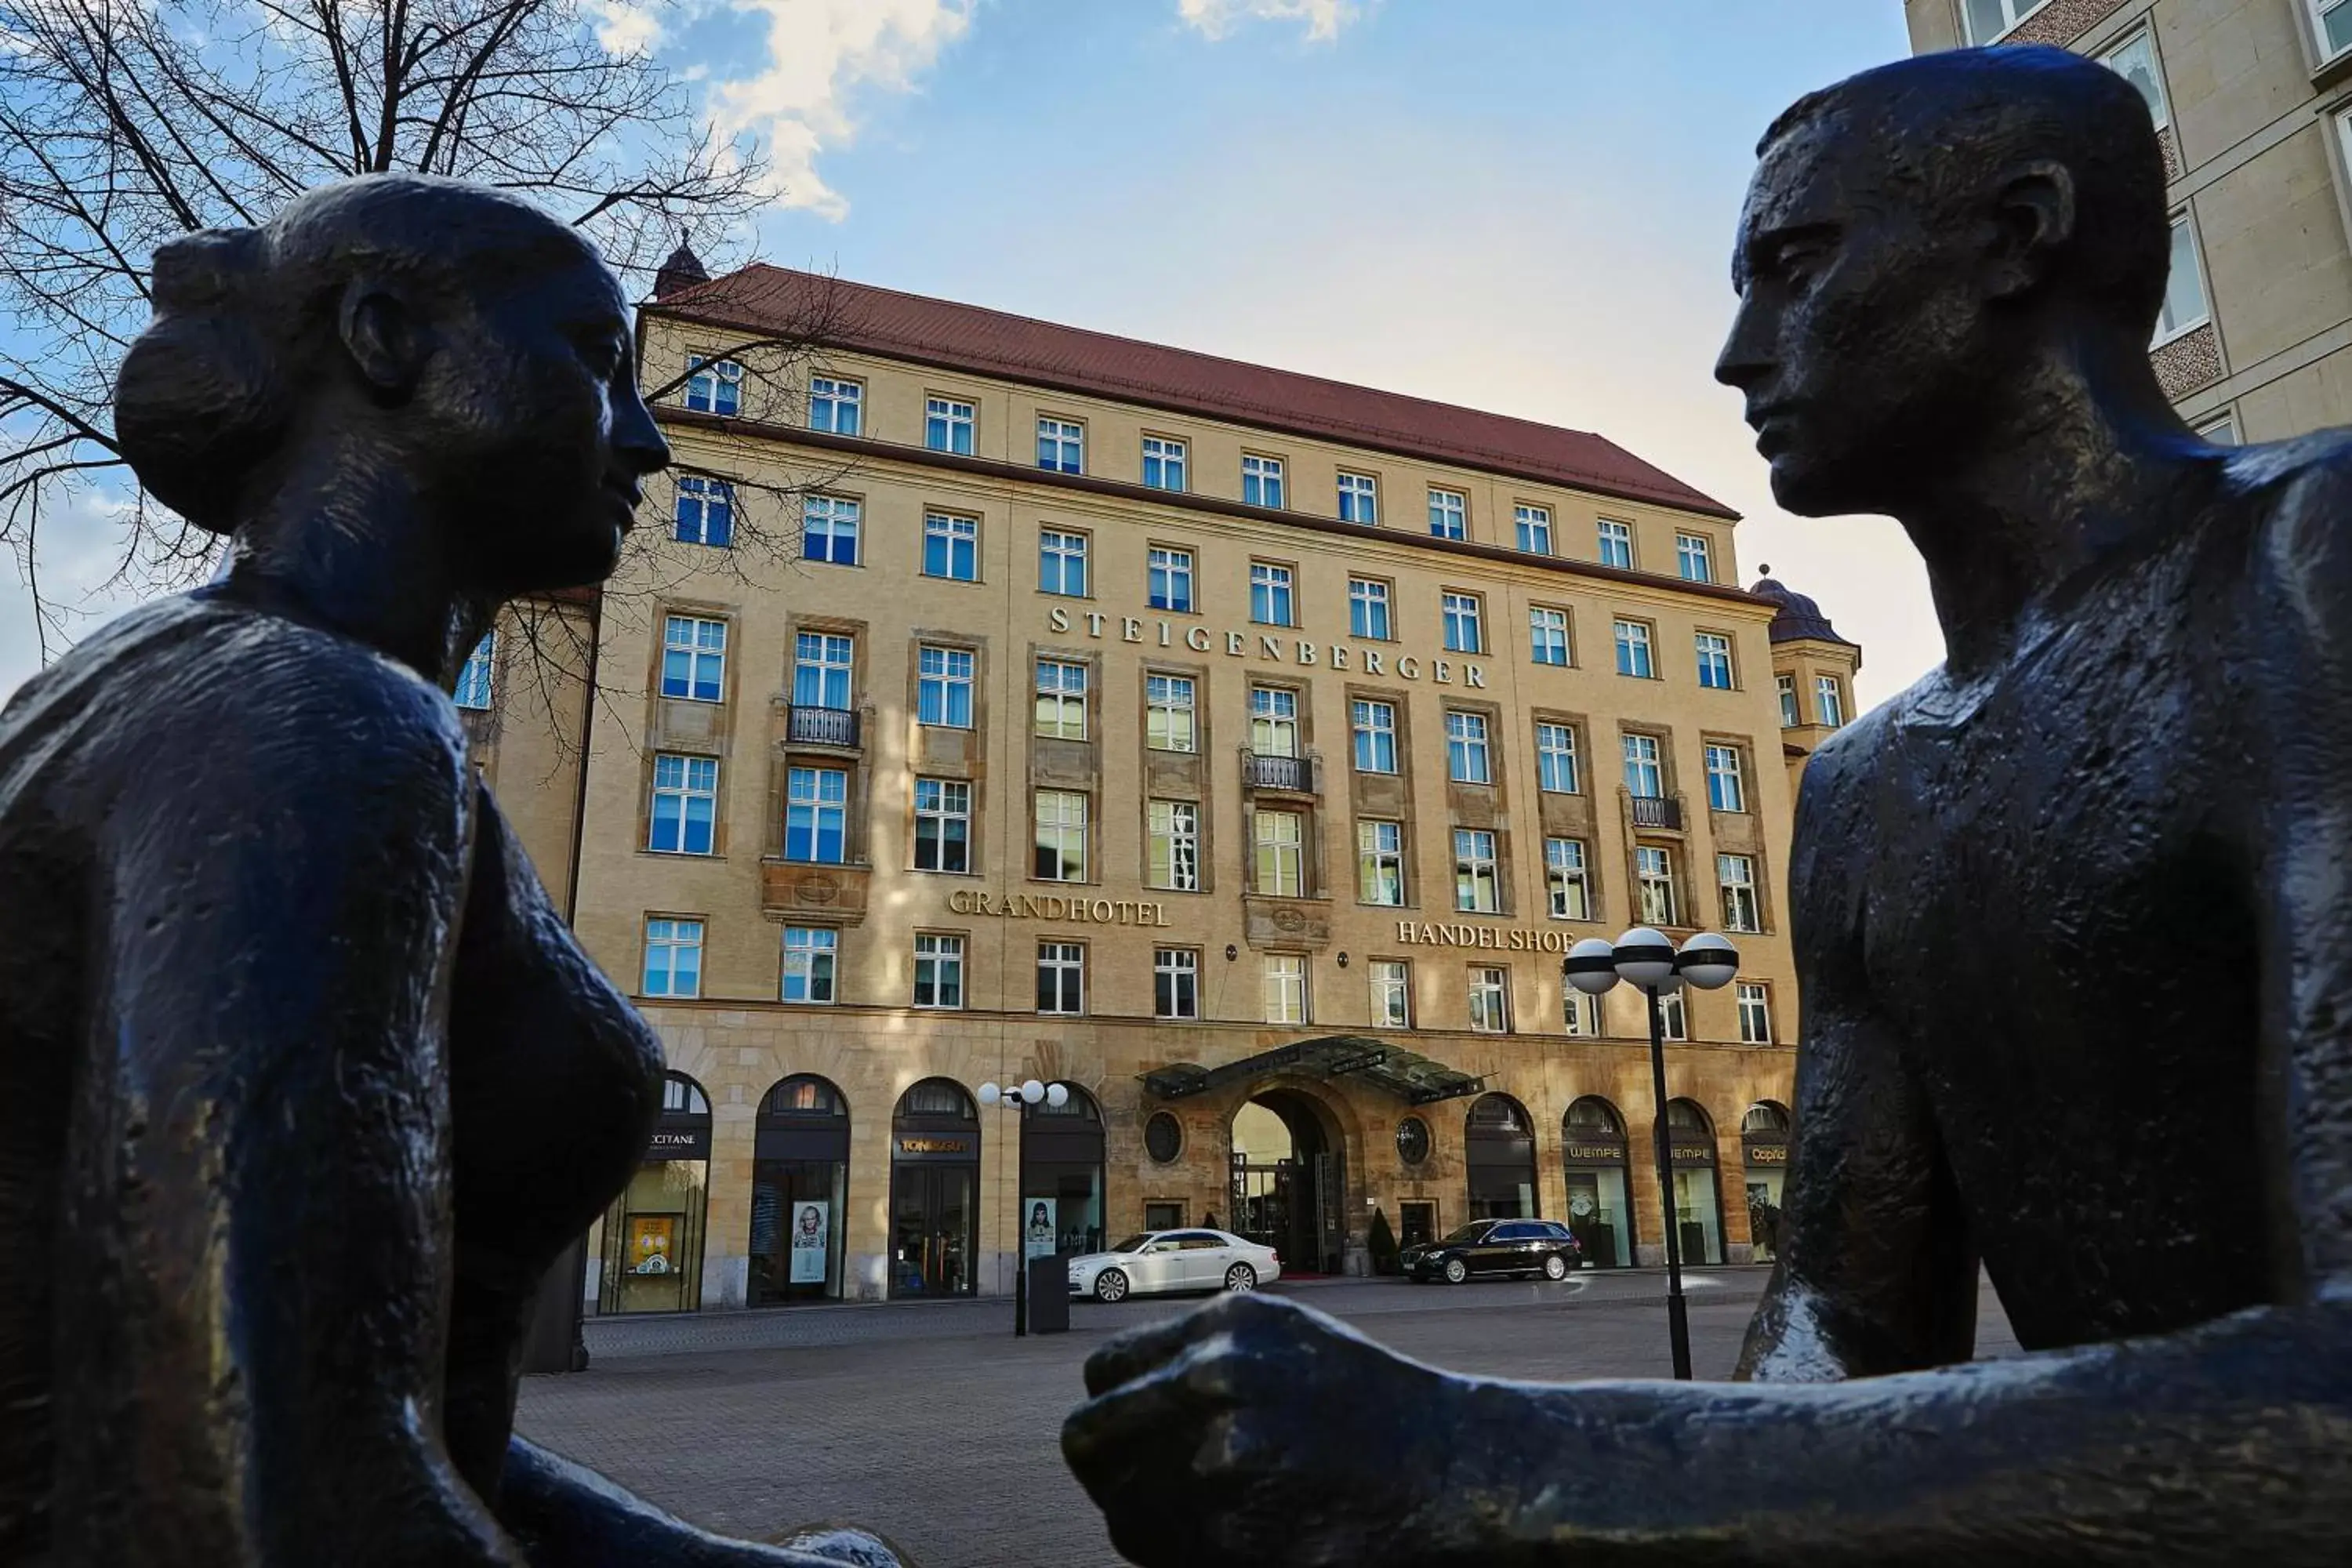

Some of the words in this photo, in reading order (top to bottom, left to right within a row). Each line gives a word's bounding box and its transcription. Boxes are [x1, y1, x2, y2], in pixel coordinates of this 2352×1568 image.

[1049, 607, 1486, 688] STEIGENBERGER
[949, 891, 1172, 927] GRANDHOTEL
[1398, 921, 1575, 953] HANDELSHOF
[1570, 1147, 1621, 1158] WEMPE
